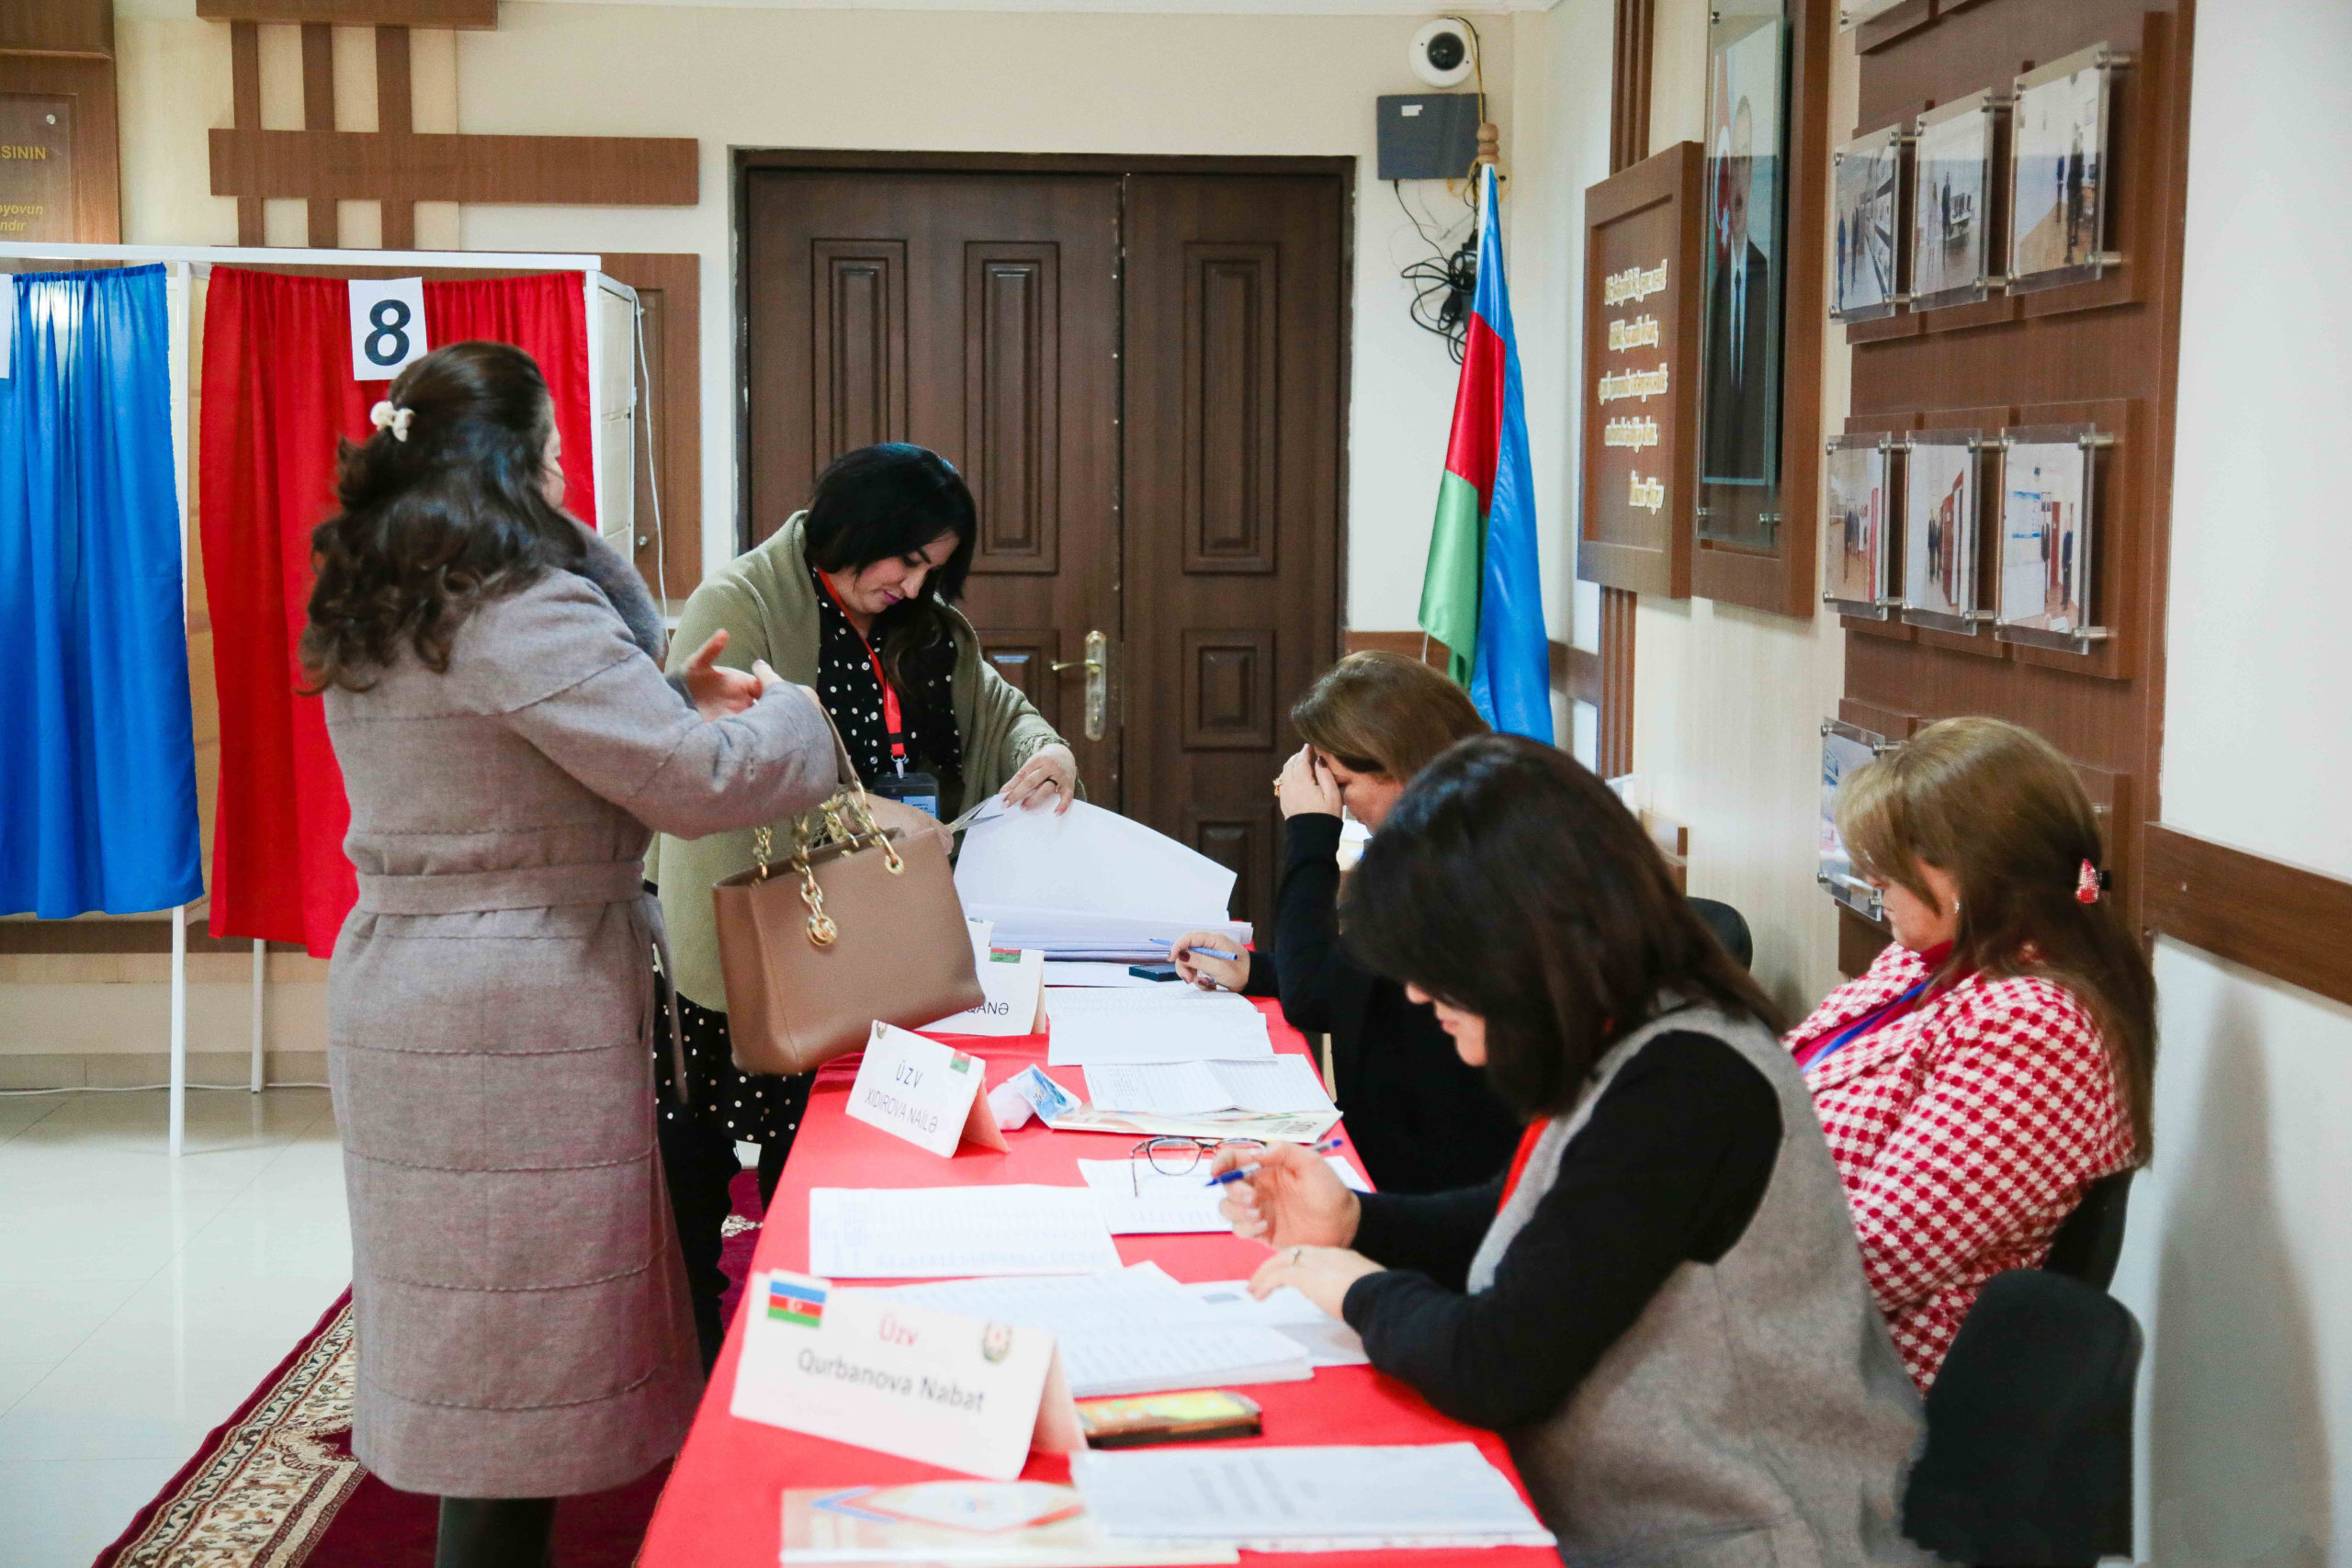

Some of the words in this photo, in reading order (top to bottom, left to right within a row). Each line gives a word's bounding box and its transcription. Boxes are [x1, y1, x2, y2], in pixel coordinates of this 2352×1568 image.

[0, 145, 46, 160] SININ
[365, 299, 411, 366] 8
[896, 1059, 923, 1089] ÜZV
[879, 1314, 919, 1347] Üzv
[797, 1348, 912, 1397] Qurbanova
[918, 1377, 985, 1413] Nabat
